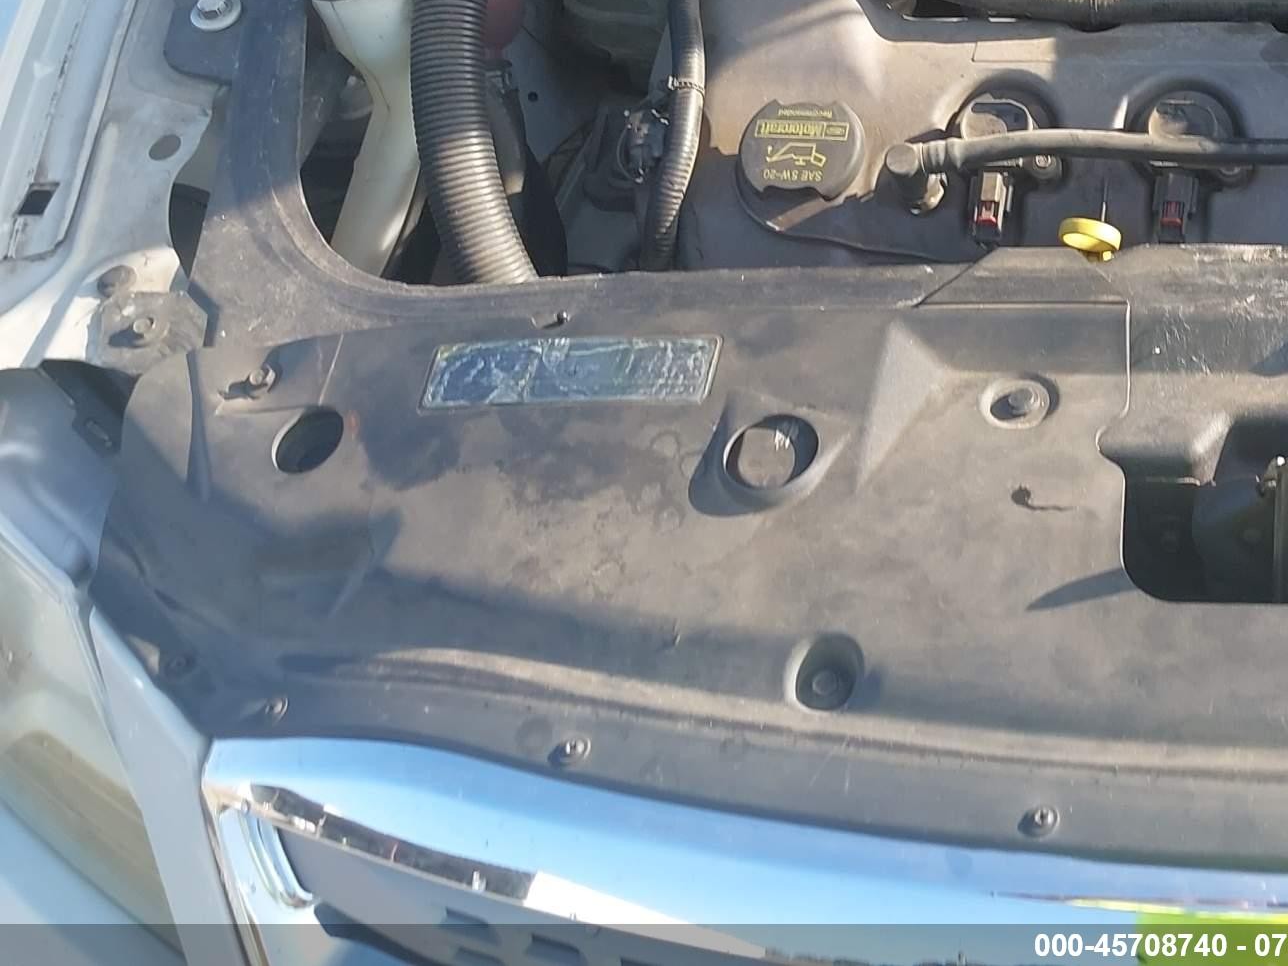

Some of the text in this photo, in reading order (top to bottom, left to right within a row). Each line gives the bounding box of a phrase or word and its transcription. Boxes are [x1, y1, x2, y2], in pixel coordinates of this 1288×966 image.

[760, 120, 824, 138] Motorcraft
[763, 169, 823, 182] SAE 5W-20
